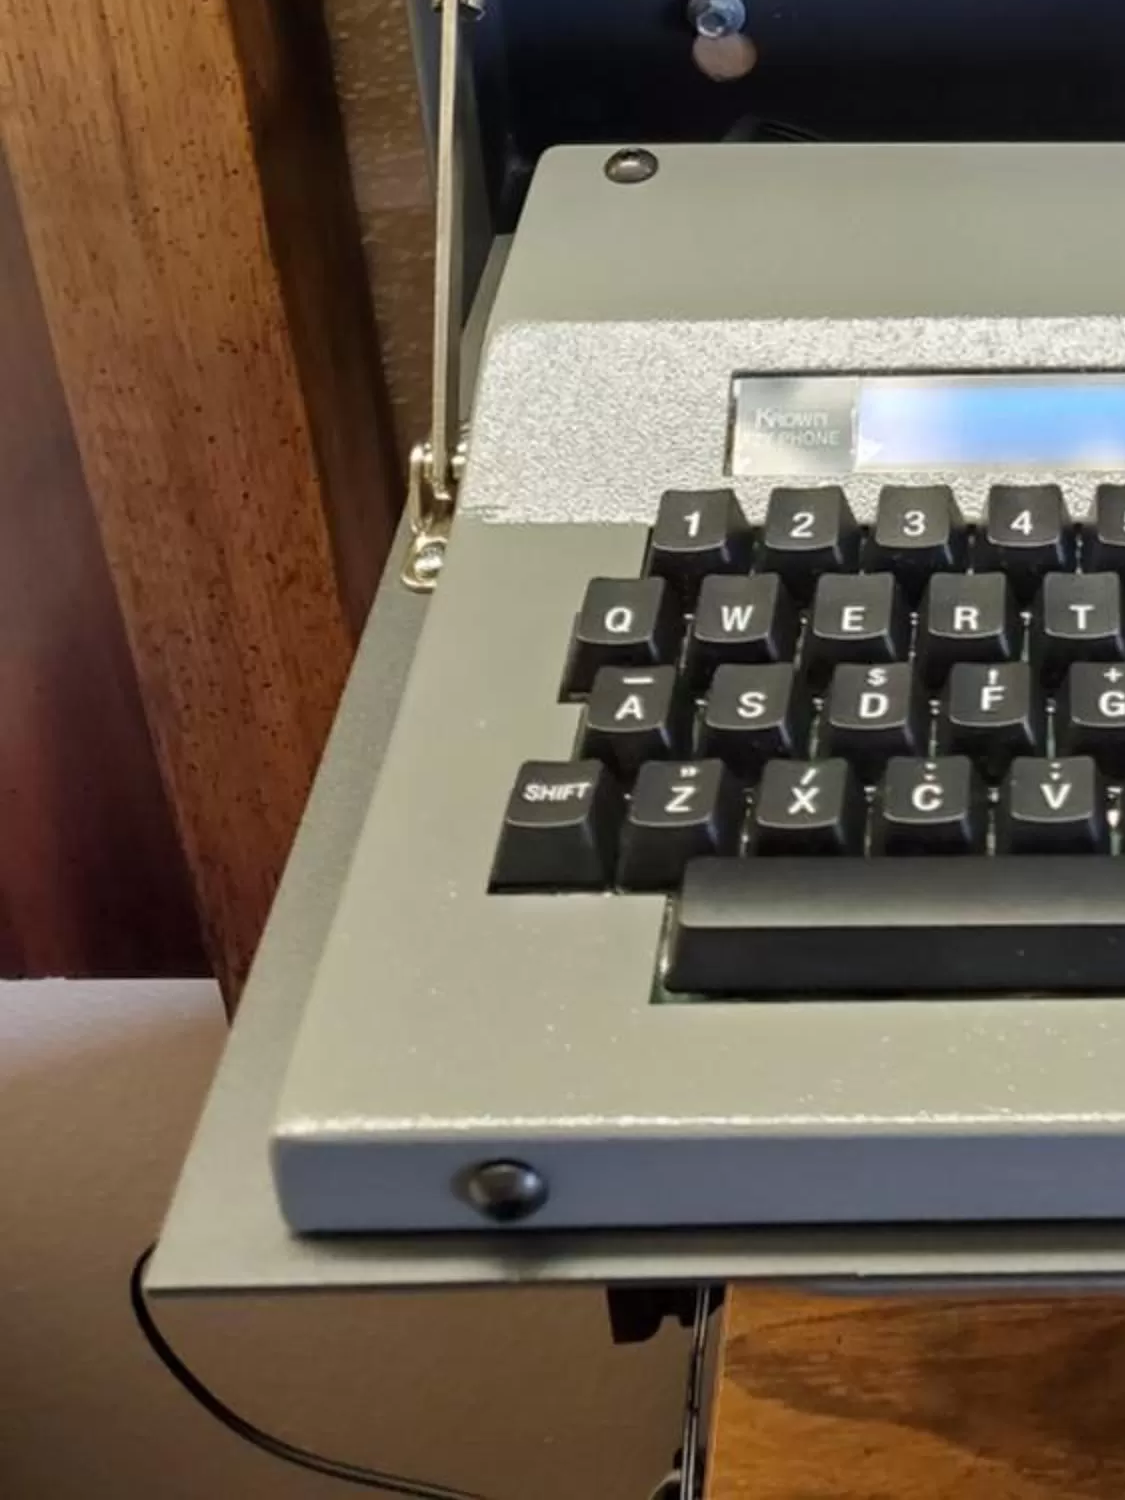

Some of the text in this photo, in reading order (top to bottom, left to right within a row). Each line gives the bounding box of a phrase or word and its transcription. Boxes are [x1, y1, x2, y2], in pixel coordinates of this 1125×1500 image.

[684, 511, 700, 537] 1
[790, 512, 815, 538] 2
[903, 510, 926, 536] 3
[1011, 510, 1033, 535] 4
[605, 606, 633, 633] Q
[721, 605, 754, 632] W
[841, 606, 865, 631] E
[954, 606, 979, 630] R
[1069, 604, 1093, 630] T
[1103, 667, 1123, 682] +
[615, 695, 644, 720] A
[737, 691, 765, 718] S
[860, 693, 888, 718] D
[981, 685, 1004, 711] F
[523, 781, 592, 802] SHIFT
[665, 785, 696, 812] Z
[788, 787, 819, 814] X
[912, 784, 942, 811] C
[1041, 783, 1071, 809] V
